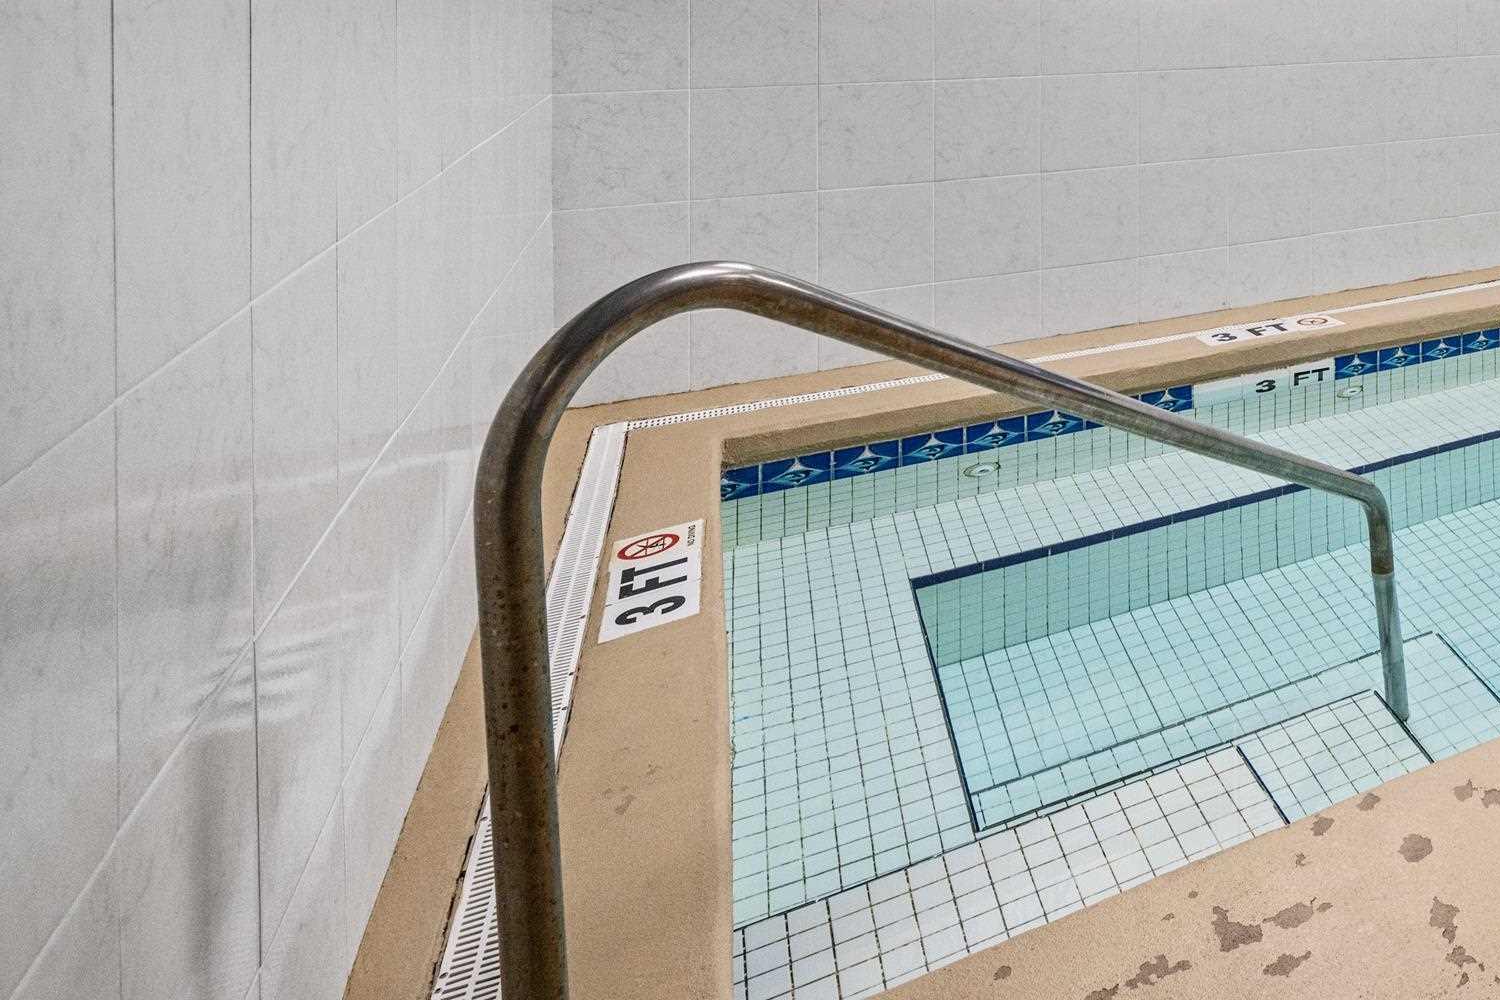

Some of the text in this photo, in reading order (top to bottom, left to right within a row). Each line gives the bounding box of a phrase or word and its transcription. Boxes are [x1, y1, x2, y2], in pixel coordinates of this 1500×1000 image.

[1212, 322, 1288, 342] 3 FT
[1256, 367, 1330, 393] 3 FT
[615, 557, 688, 625] 3 FT
